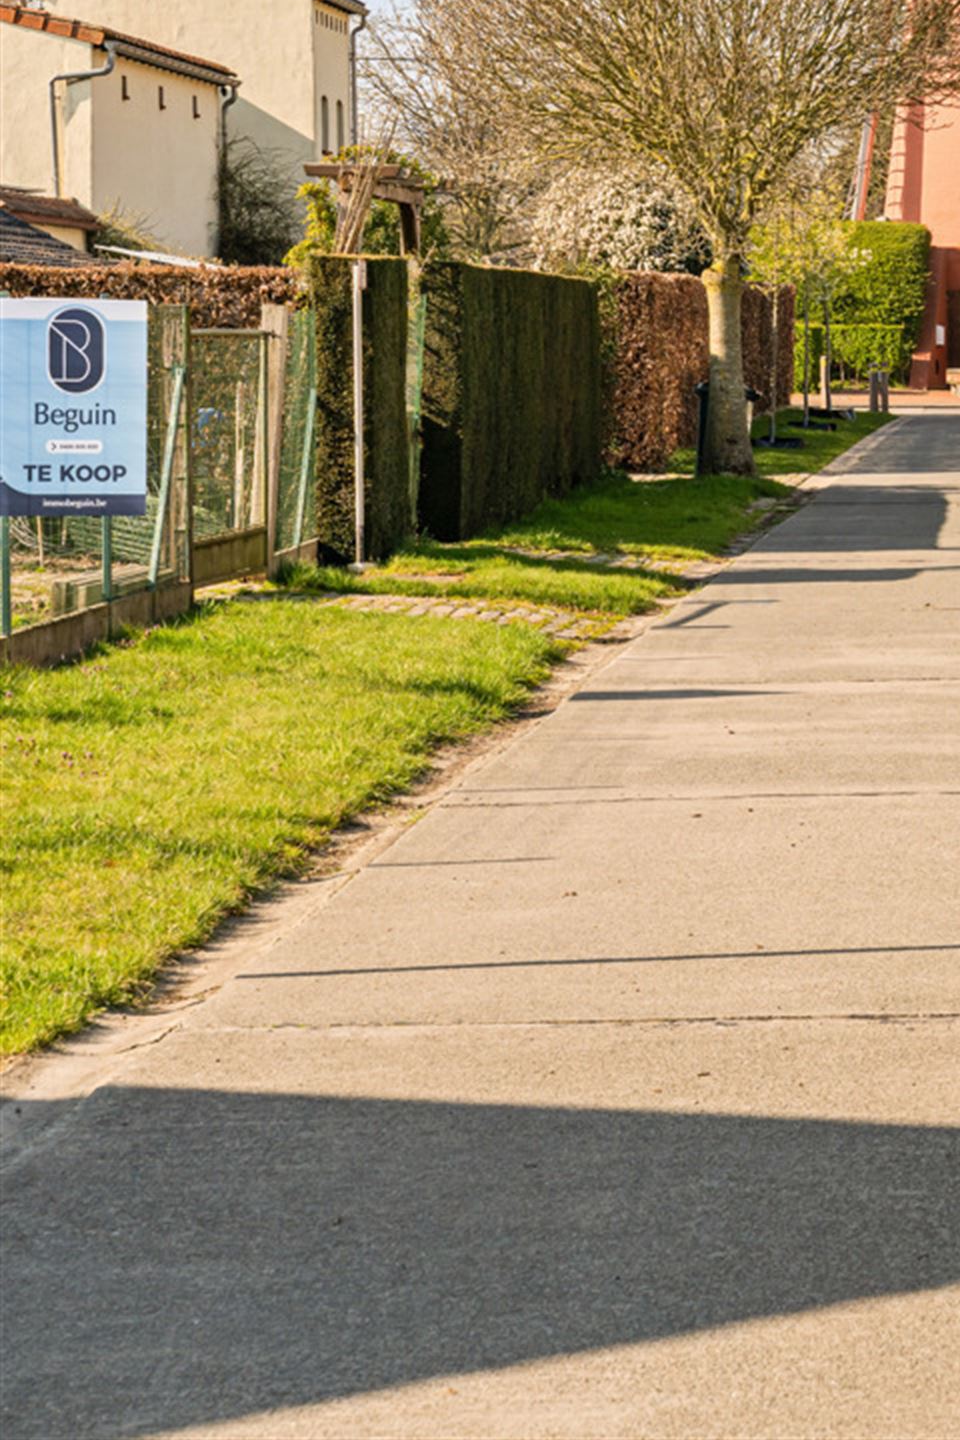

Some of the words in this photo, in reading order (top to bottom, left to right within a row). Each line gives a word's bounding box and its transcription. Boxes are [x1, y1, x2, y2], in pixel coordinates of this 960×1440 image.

[34, 402, 116, 433] Beguin
[23, 464, 50, 482] TE
[60, 465, 127, 482] KOOP
